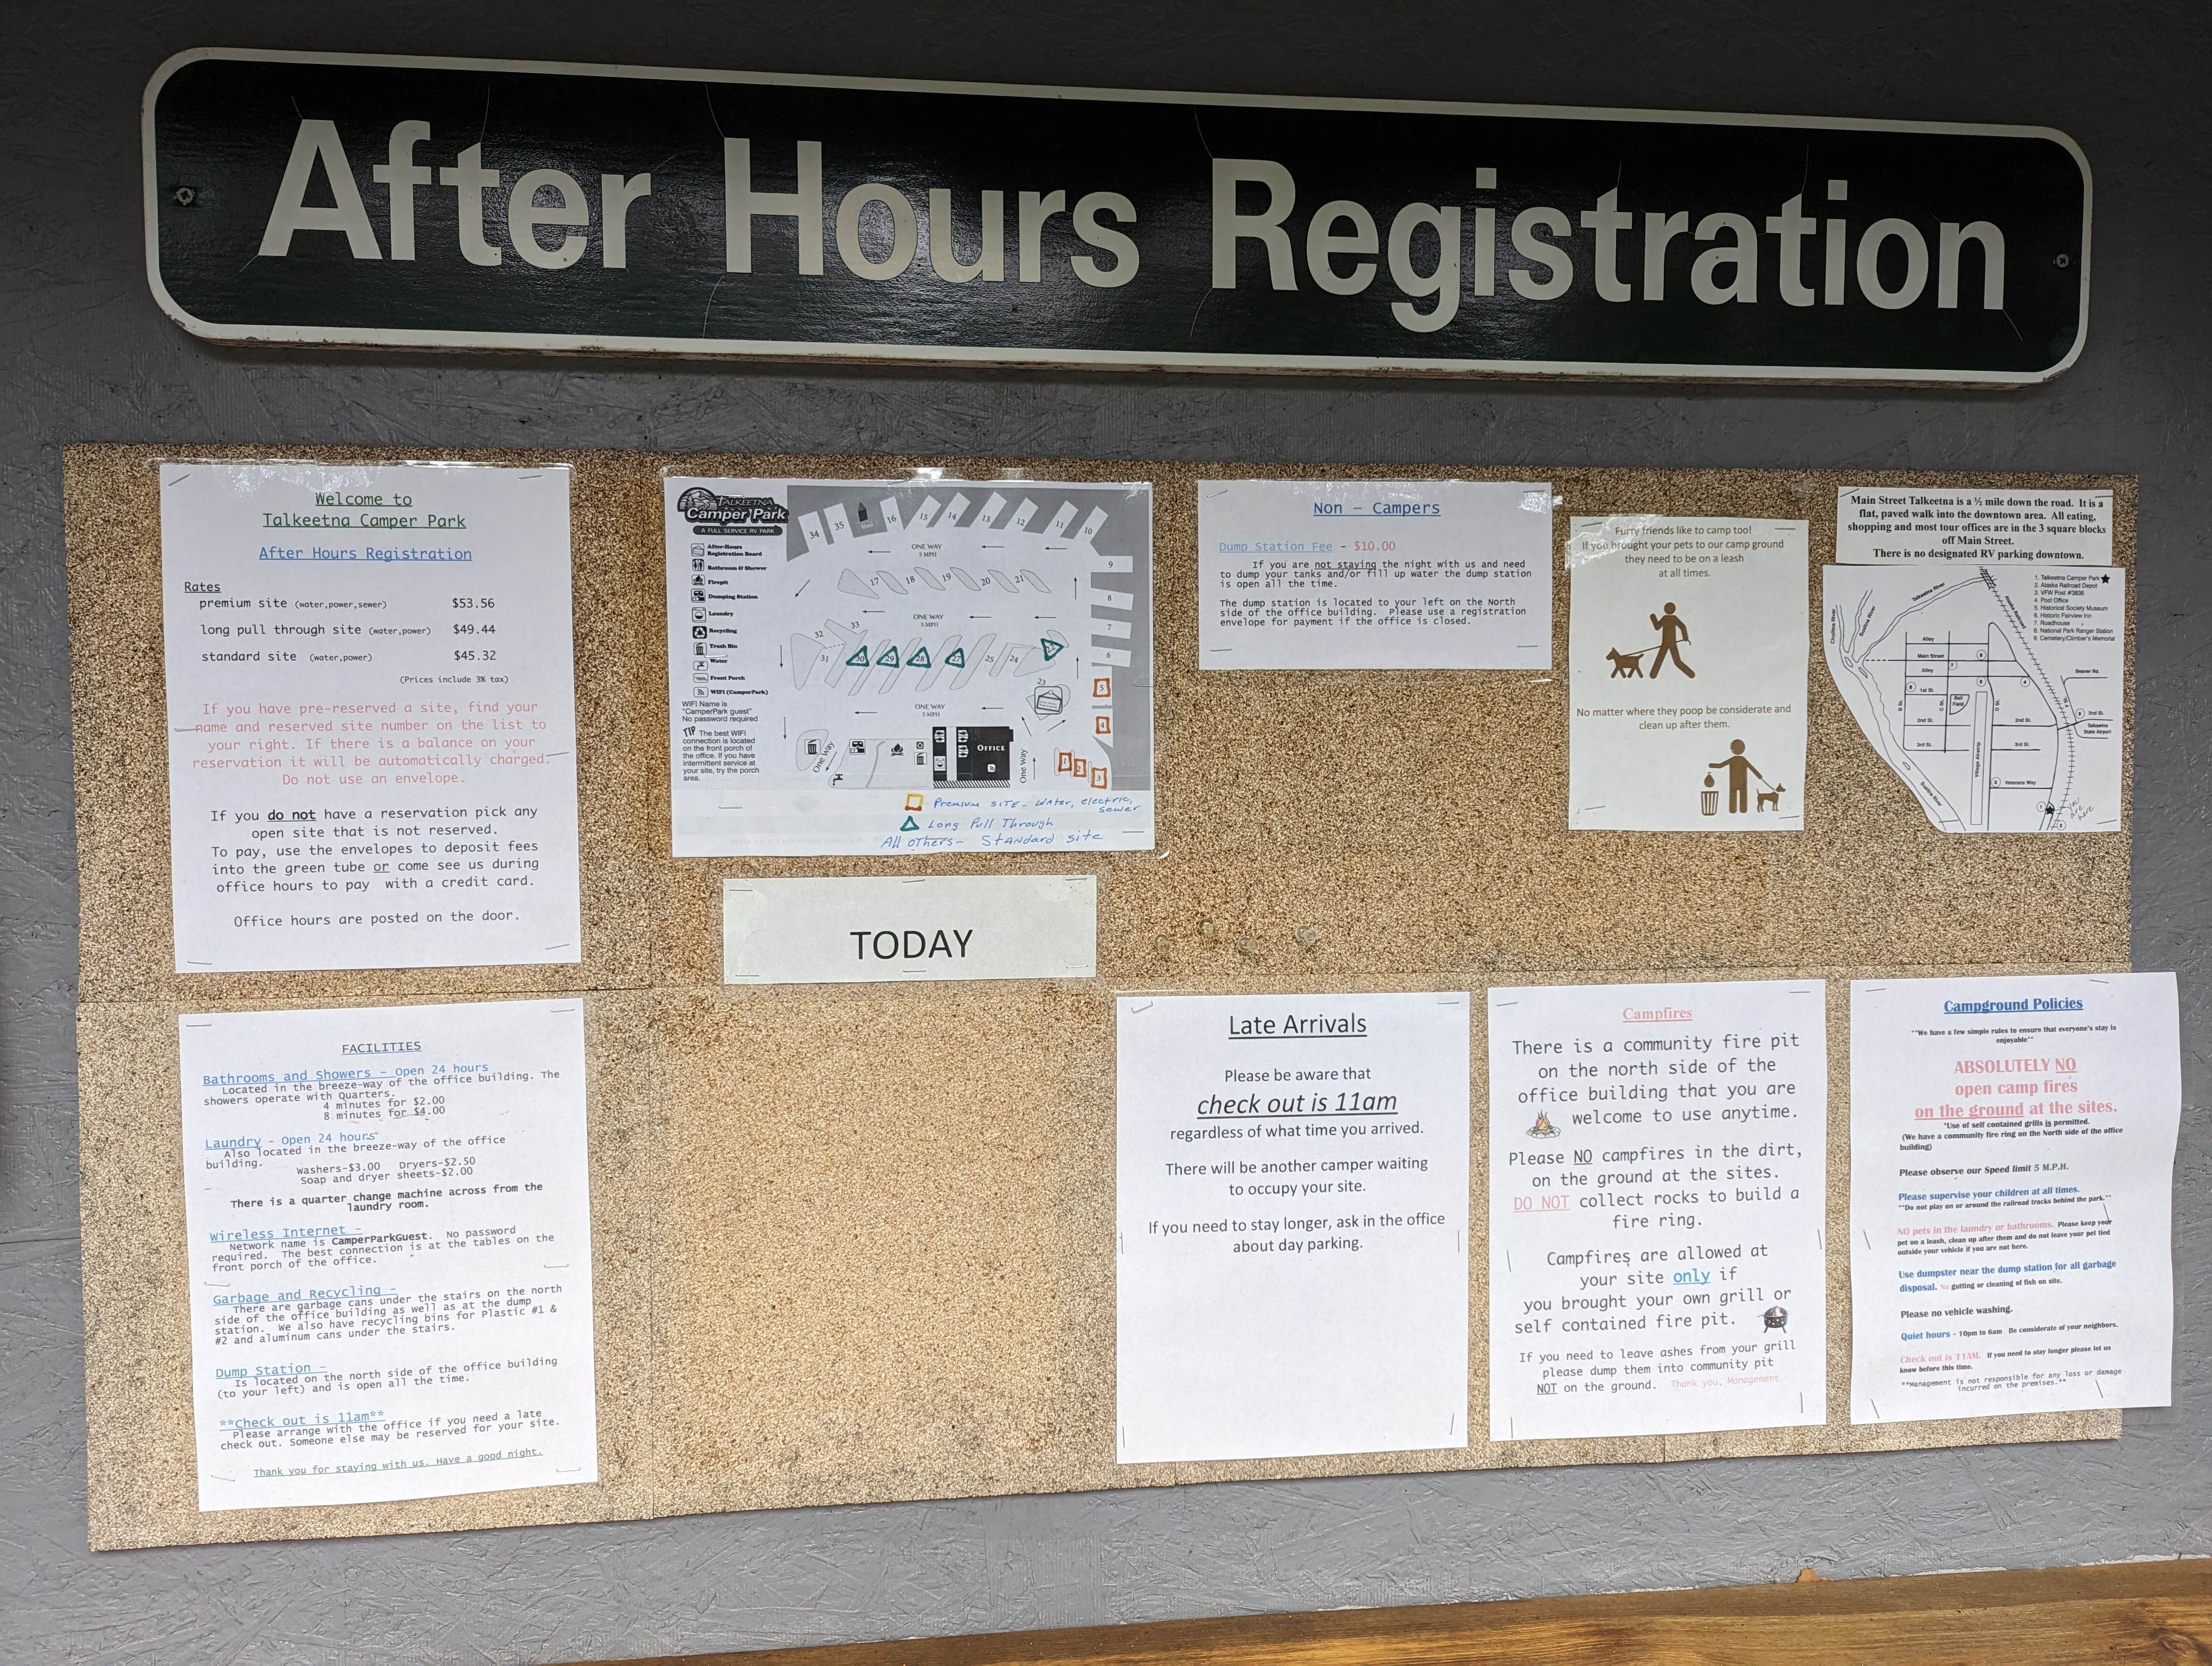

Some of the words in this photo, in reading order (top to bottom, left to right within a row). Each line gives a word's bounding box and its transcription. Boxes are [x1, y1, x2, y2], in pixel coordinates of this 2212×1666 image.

[258, 119, 651, 269] After
[724, 138, 1139, 287] Hours
[1212, 158, 2005, 332] Registration
[315, 491, 382, 507] Welcome
[393, 492, 413, 506] to
[717, 497, 774, 506] TALKEETNA
[687, 508, 748, 521] Camper
[753, 509, 786, 520] Park
[1314, 502, 1342, 515] Non
[1372, 502, 1441, 517] Campers
[263, 513, 350, 528] Talkeetna
[360, 514, 417, 529] Camper
[428, 514, 466, 528] Park
[1017, 518, 1025, 526] 12
[1219, 542, 1248, 553] Dump
[1255, 542, 1304, 552] Station
[1312, 542, 1333, 552] Fee
[1354, 541, 1396, 552] $10.00
[1942, 536, 1956, 544] off
[1958, 536, 1982, 544] Main
[1984, 536, 2014, 545] Street.
[260, 547, 305, 560] After
[313, 547, 356, 560] Hours
[366, 547, 472, 561] Registration
[1873, 548, 1901, 558] There
[1904, 549, 1911, 558] is
[1928, 549, 1977, 560] designated
[1980, 549, 1995, 558] RV
[1998, 549, 2033, 560] parking
[2036, 550, 2084, 559] downtown.
[1670, 568, 1680, 577] all
[1683, 568, 1711, 577] times.
[184, 582, 221, 593] Rates
[1220, 580, 1231, 588] is
[1237, 582, 1259, 590] open
[1265, 580, 1281, 588] all
[1288, 580, 1304, 588] the
[1310, 580, 1338, 588] time.
[200, 598, 251, 610] premium
[259, 597, 287, 608] site
[295, 599, 387, 610] (water,power,sewer)
[452, 598, 495, 609] $53.56
[202, 651, 260, 661] standard
[268, 651, 297, 661] site
[310, 653, 372, 663] (water,power)
[454, 650, 497, 661] $45.32
[400, 676, 433, 684] (Prices
[490, 676, 508, 684] tax)
[1639, 721, 1663, 729] clean
[1666, 722, 1677, 731] up
[1680, 720, 1701, 729] after
[1704, 720, 1730, 728] them.
[850, 930, 973, 959] TODAY
[1944, 999, 2028, 1014] Campground
[2033, 998, 2084, 1011] Policies
[1623, 1007, 1693, 1022] Campfires
[1230, 1015, 1276, 1035] Late
[1283, 1013, 1367, 1034] Arrivals
[342, 1041, 421, 1054] FACILITIES
[1954, 1058, 2050, 1074] ABSOLUTELY
[2055, 1058, 2077, 1073] NO
[1955, 1085, 1991, 1098] open
[1997, 1083, 2039, 1097] camp
[2043, 1079, 2078, 1094] fires
[336, 1100, 381, 1110] minutes
[388, 1098, 407, 1107] for
[413, 1095, 445, 1106] $2.00
[1198, 1093, 1261, 1115] check
[1268, 1095, 1305, 1113] out
[1311, 1093, 1328, 1112] is
[1334, 1092, 1397, 1112] 11am
[297, 1162, 381, 1175] Washers-$3.00
[399, 1156, 476, 1170] Dryers-$2.50
[1899, 1168, 1928, 1177] Please
[1931, 1167, 1964, 1176] observe
[1984, 1165, 2010, 1176] Speed
[2012, 1164, 2032, 1173] limit
[2034, 1164, 2040, 1172] 5
[2042, 1163, 2069, 1171] M.P.H.
[1229, 1184, 1244, 1196] to
[1248, 1184, 1298, 1198] occupy
[1302, 1183, 1334, 1196] your
[1338, 1180, 1367, 1193] site.
[347, 1201, 393, 1212] laundry
[399, 1201, 429, 1210] room.
[1612, 1214, 1649, 1229] fire
[1659, 1212, 1703, 1229] ring.
[210, 1228, 274, 1242] Wireless
[282, 1225, 346, 1238] Internet
[1580, 1274, 1617, 1291] your
[1627, 1271, 1664, 1285] site
[1673, 1268, 1711, 1285] only
[1720, 1266, 1738, 1281] if
[1901, 1309, 1929, 1319] Please
[1944, 1307, 1974, 1316] vehicle
[1976, 1305, 2014, 1316] washing.
[1537, 1383, 1558, 1395] NOT
[1564, 1385, 1577, 1393] on
[1584, 1381, 1604, 1392] the
[1611, 1379, 1657, 1394] ground.
[1671, 1379, 1697, 1388] Thank
[1702, 1379, 1722, 1389] you,
[1727, 1374, 1779, 1386] Management
